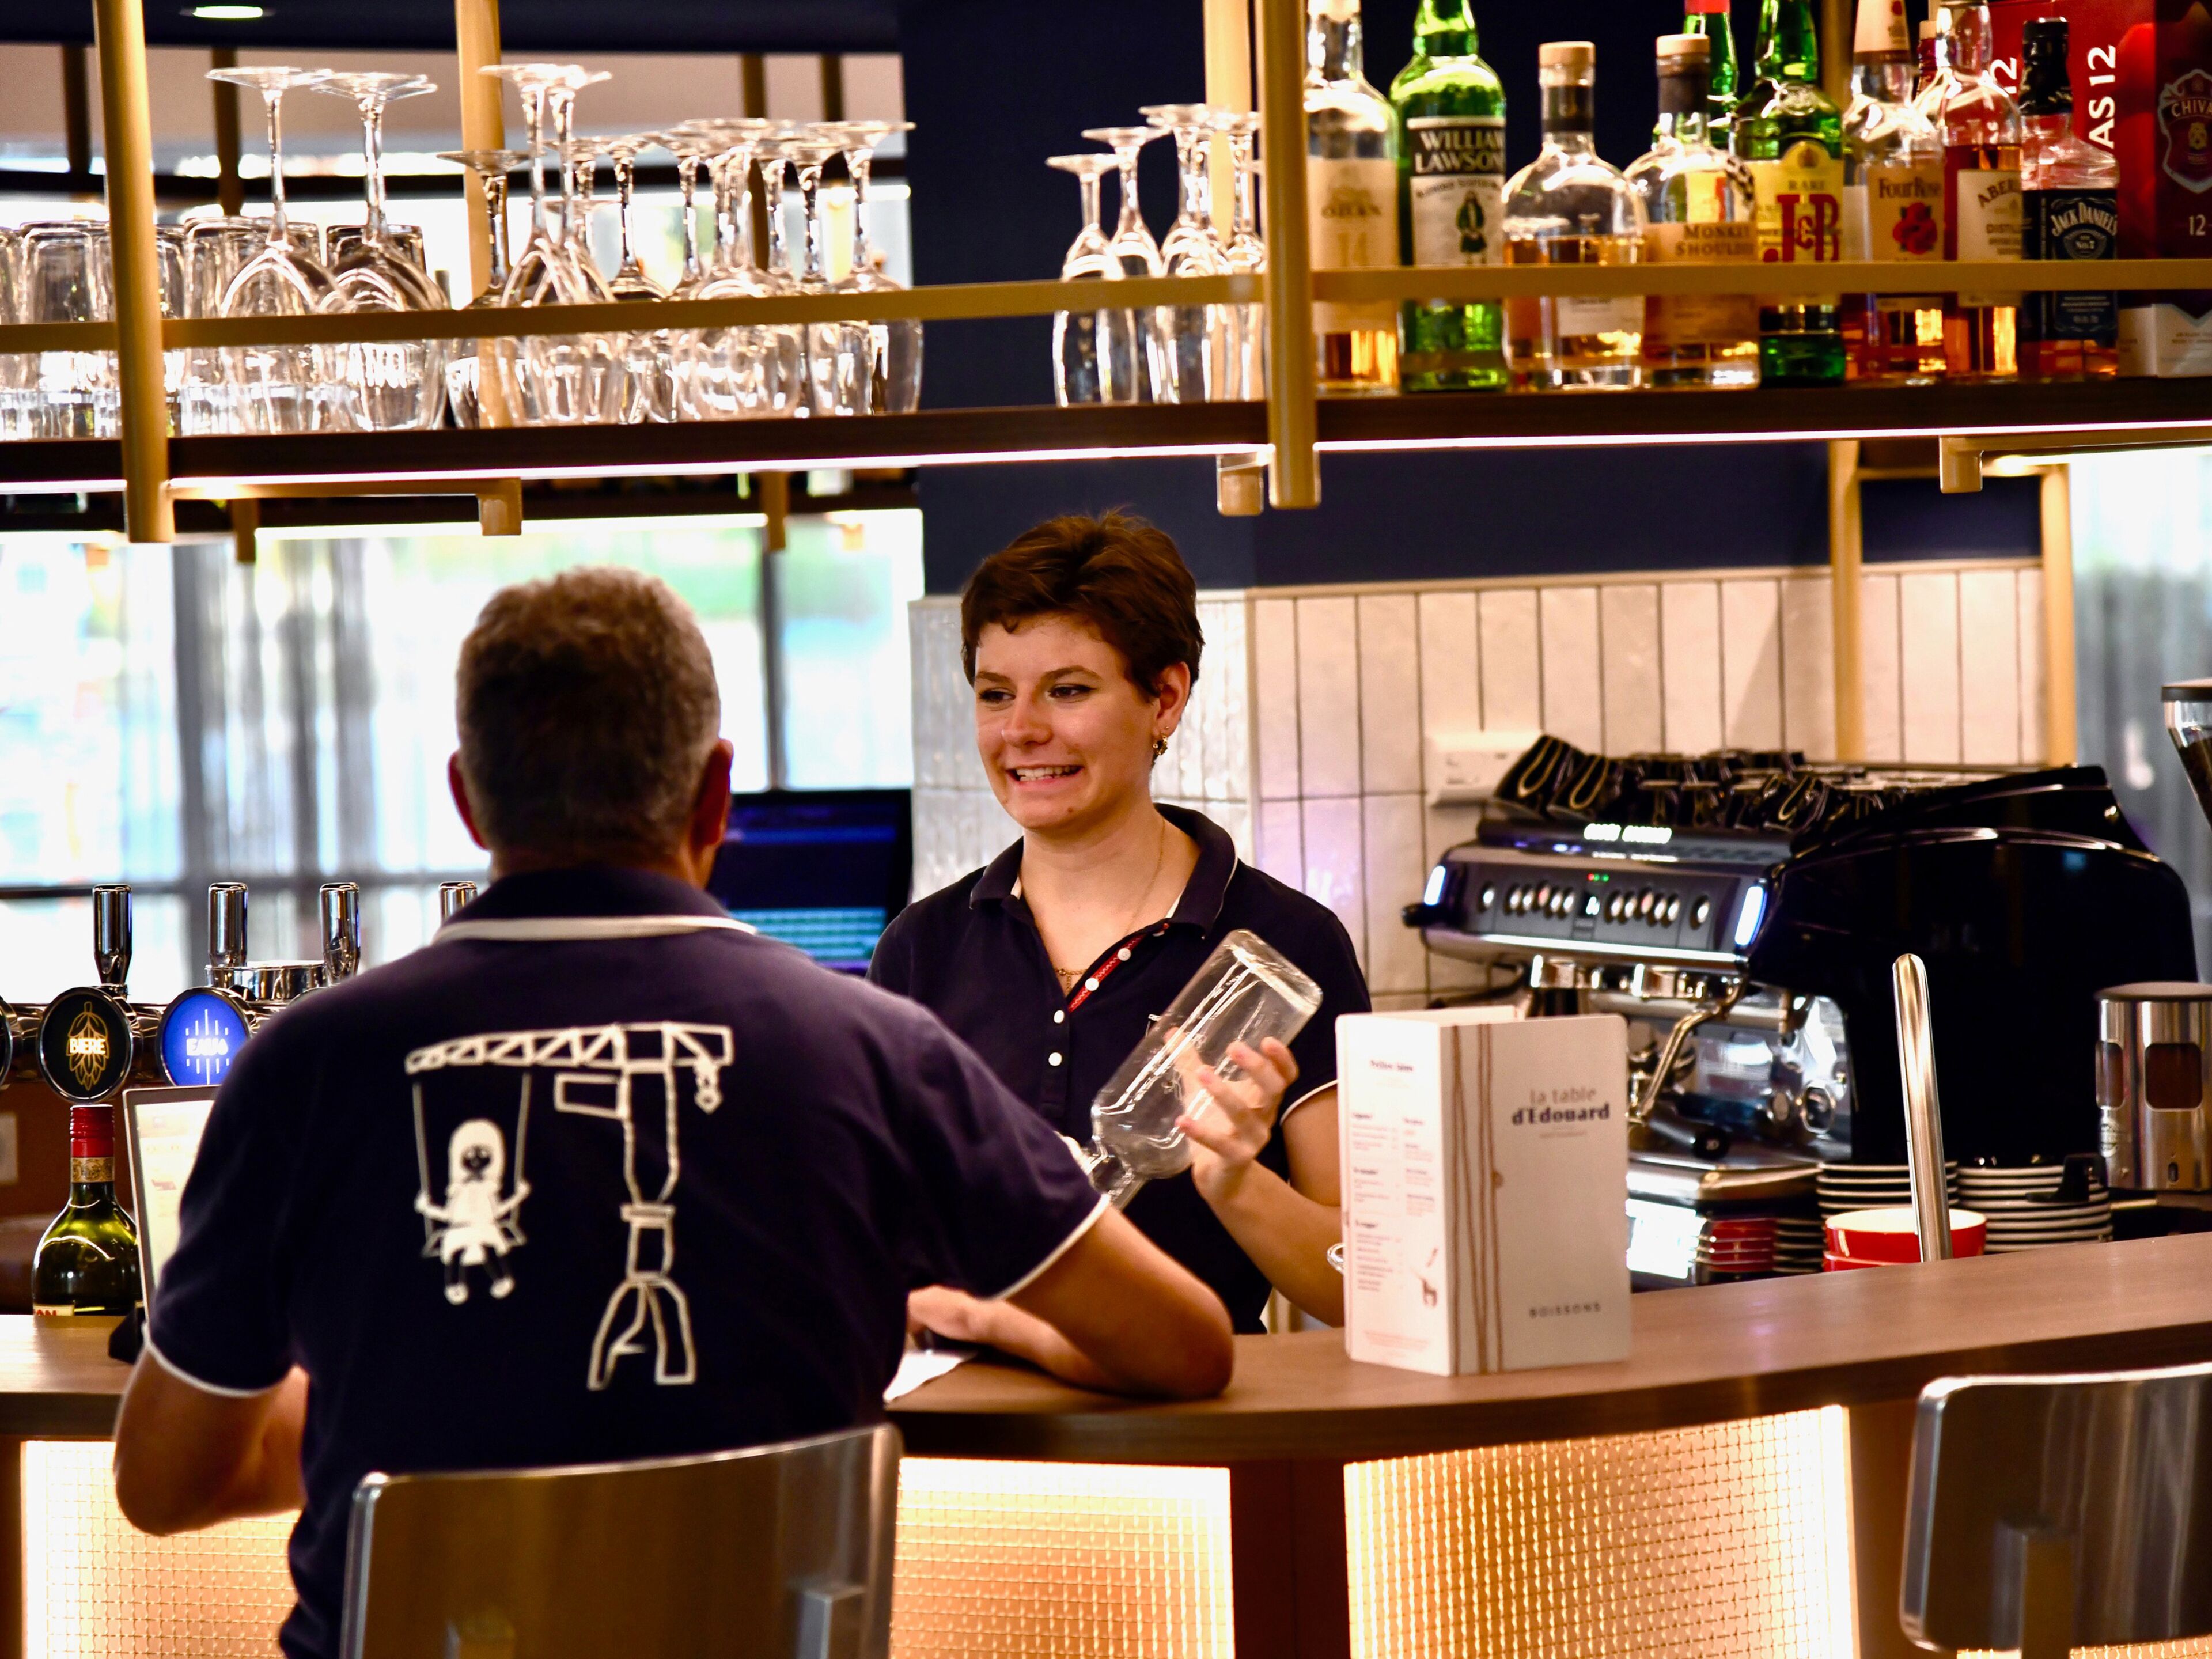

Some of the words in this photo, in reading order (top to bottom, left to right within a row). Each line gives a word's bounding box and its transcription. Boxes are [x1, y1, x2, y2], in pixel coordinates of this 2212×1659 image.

[2088, 45, 2116, 86] 12
[2188, 214, 2206, 236] 12
[1552, 1087, 1596, 1104] table
[1529, 1301, 1601, 1319] BOISSONS
